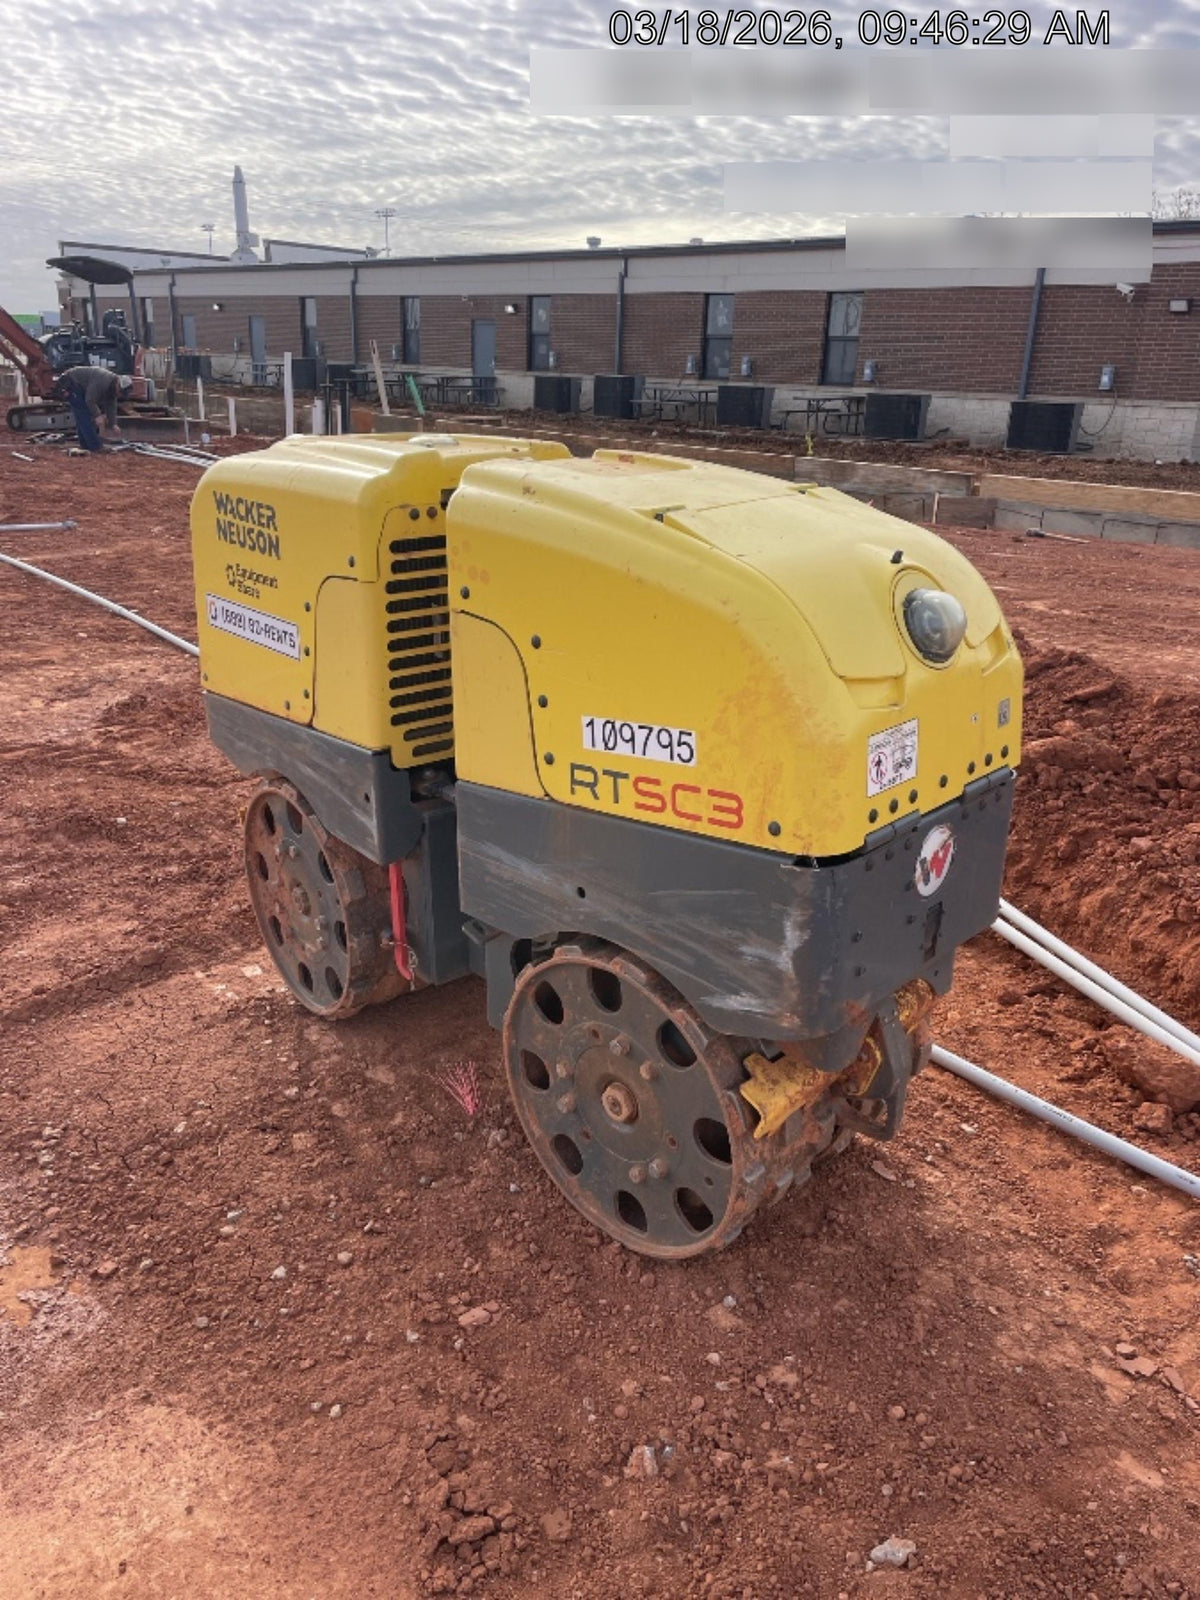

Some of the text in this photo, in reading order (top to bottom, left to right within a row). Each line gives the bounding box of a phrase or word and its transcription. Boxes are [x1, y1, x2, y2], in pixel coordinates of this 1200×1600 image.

[213, 490, 278, 532] WACKER
[216, 517, 281, 560] NEUSON
[585, 717, 695, 764] 109795
[569, 762, 744, 830] RTSC3
